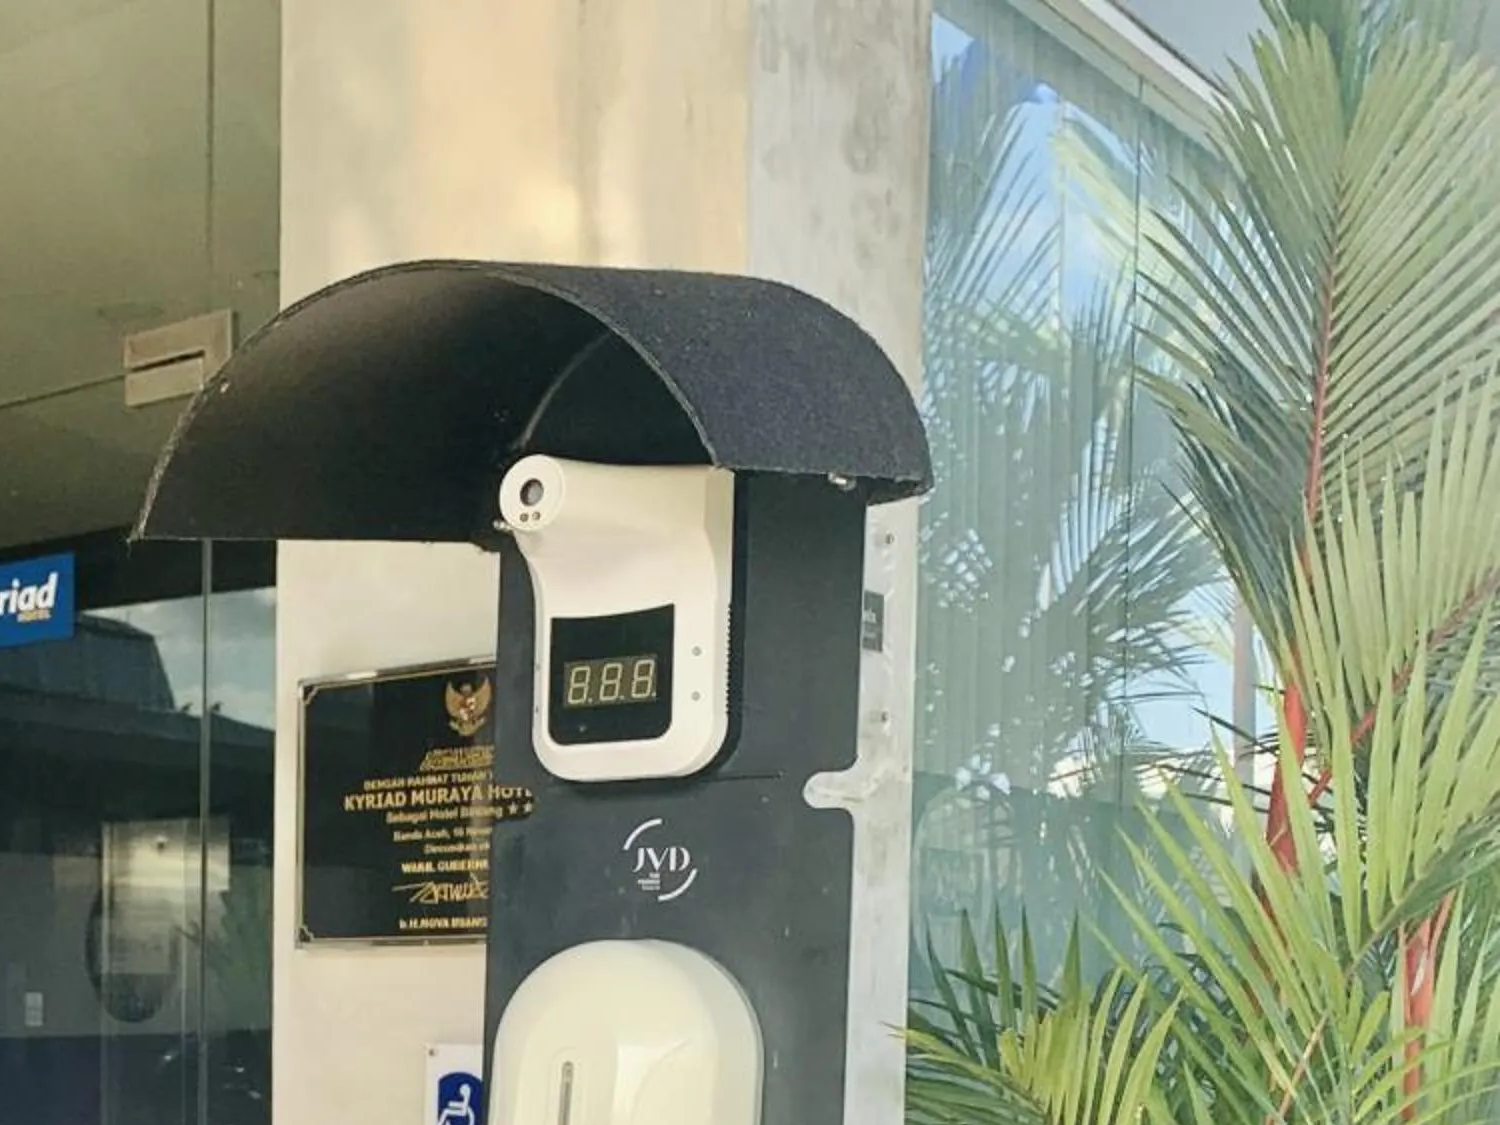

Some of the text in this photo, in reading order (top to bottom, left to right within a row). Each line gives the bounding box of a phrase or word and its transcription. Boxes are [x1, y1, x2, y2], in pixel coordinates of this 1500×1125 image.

[344, 790, 407, 811] KYRIAD
[411, 785, 484, 806] MURAYA
[632, 846, 690, 872] JVD
